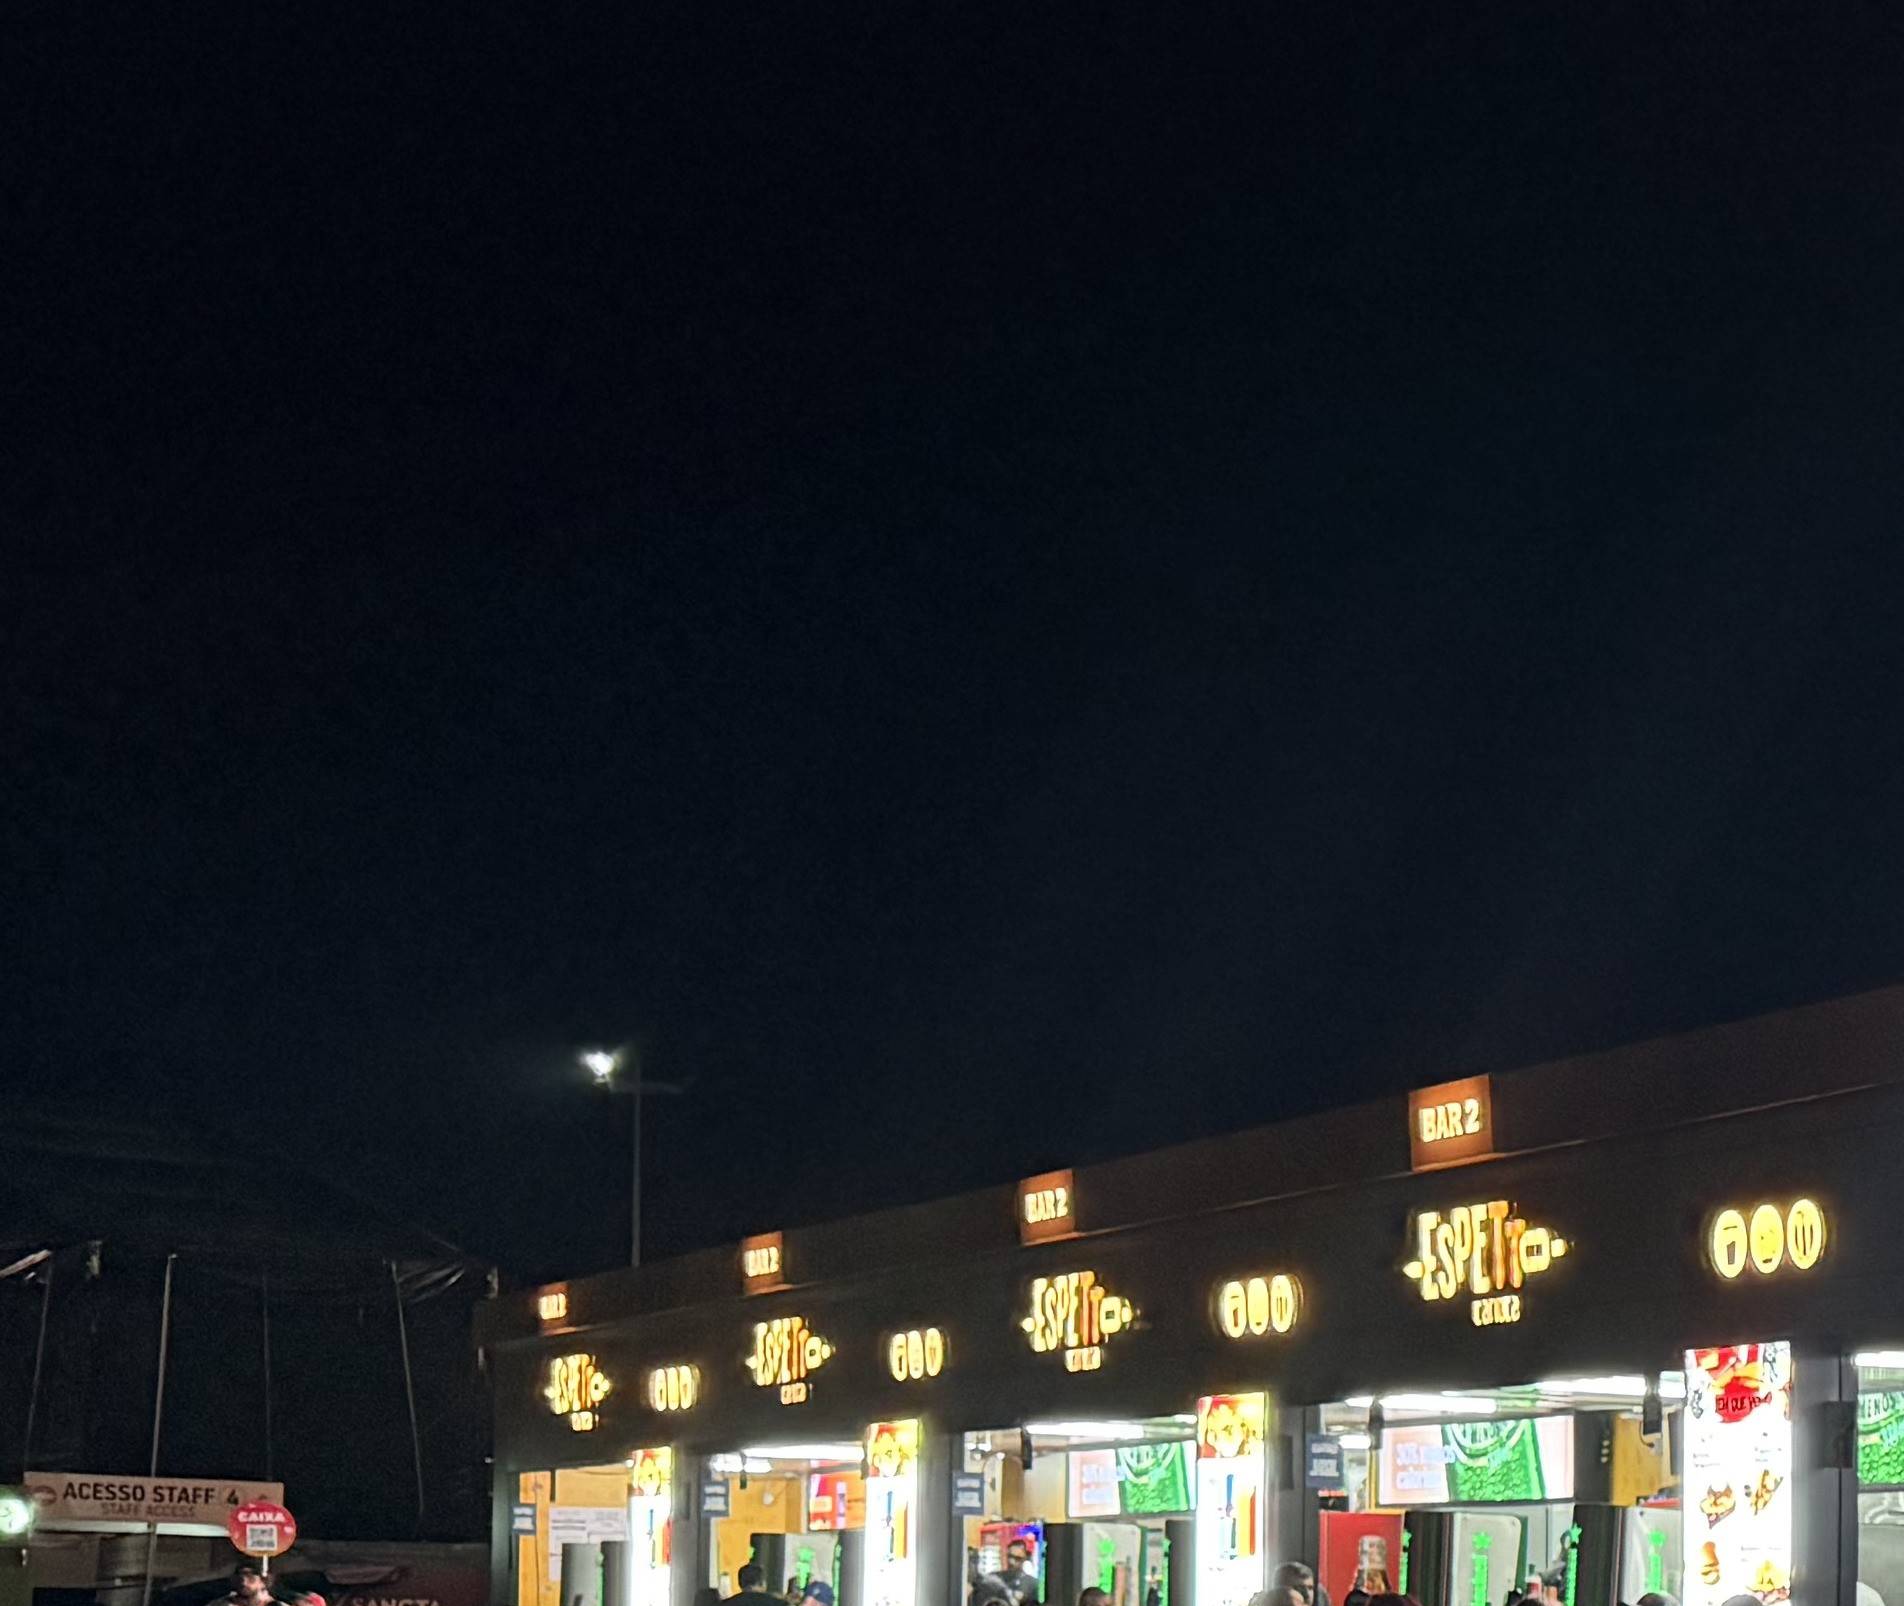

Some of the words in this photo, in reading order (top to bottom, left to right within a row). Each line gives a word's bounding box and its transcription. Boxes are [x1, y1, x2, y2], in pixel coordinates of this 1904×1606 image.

[1418, 1102, 1464, 1143] BAR
[1463, 1098, 1481, 1134] 2
[1024, 1190, 1056, 1224] BAR
[1055, 1187, 1068, 1218] 2
[62, 1481, 146, 1502] ACESSO
[152, 1485, 216, 1505] STAFF
[226, 1488, 239, 1506] 4
[100, 1502, 141, 1516] STAFF
[236, 1510, 287, 1524] CAIXA
